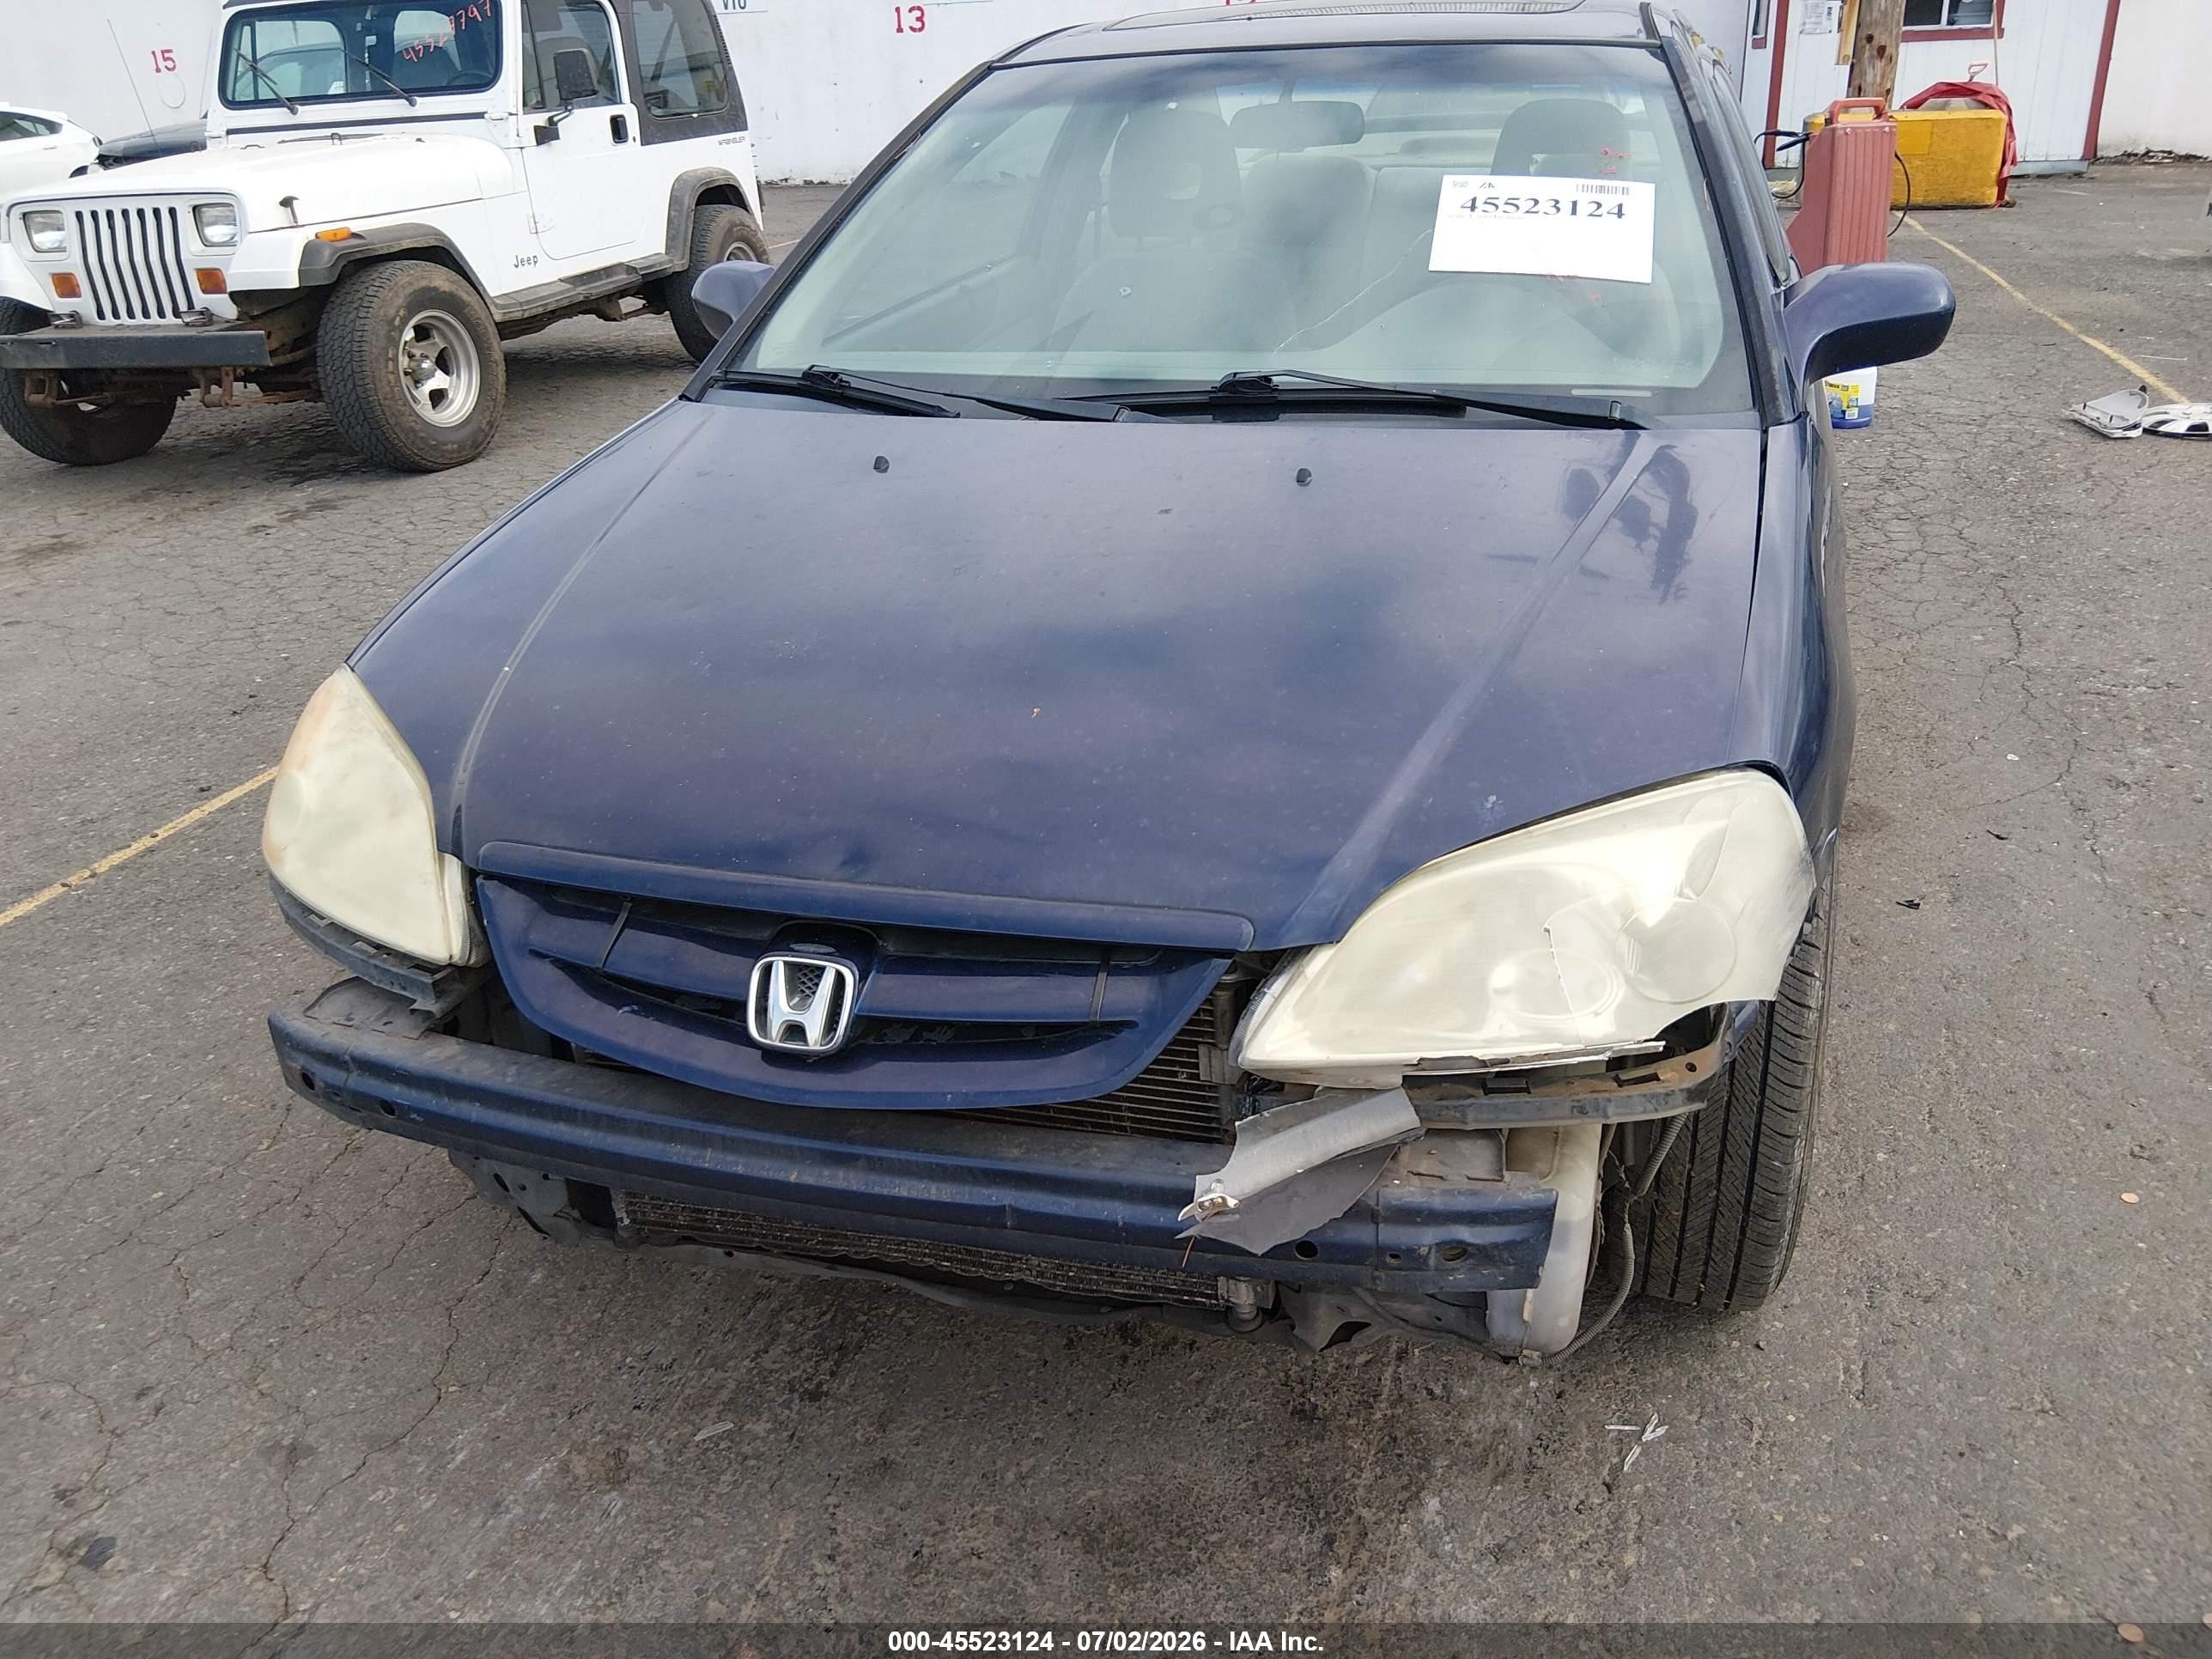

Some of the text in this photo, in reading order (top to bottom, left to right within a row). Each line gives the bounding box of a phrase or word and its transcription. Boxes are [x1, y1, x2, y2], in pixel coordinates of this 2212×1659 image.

[895, 5, 926, 33] 13
[151, 49, 177, 74] 15
[1460, 196, 1626, 219] 45523124
[514, 254, 538, 268] Jeep
